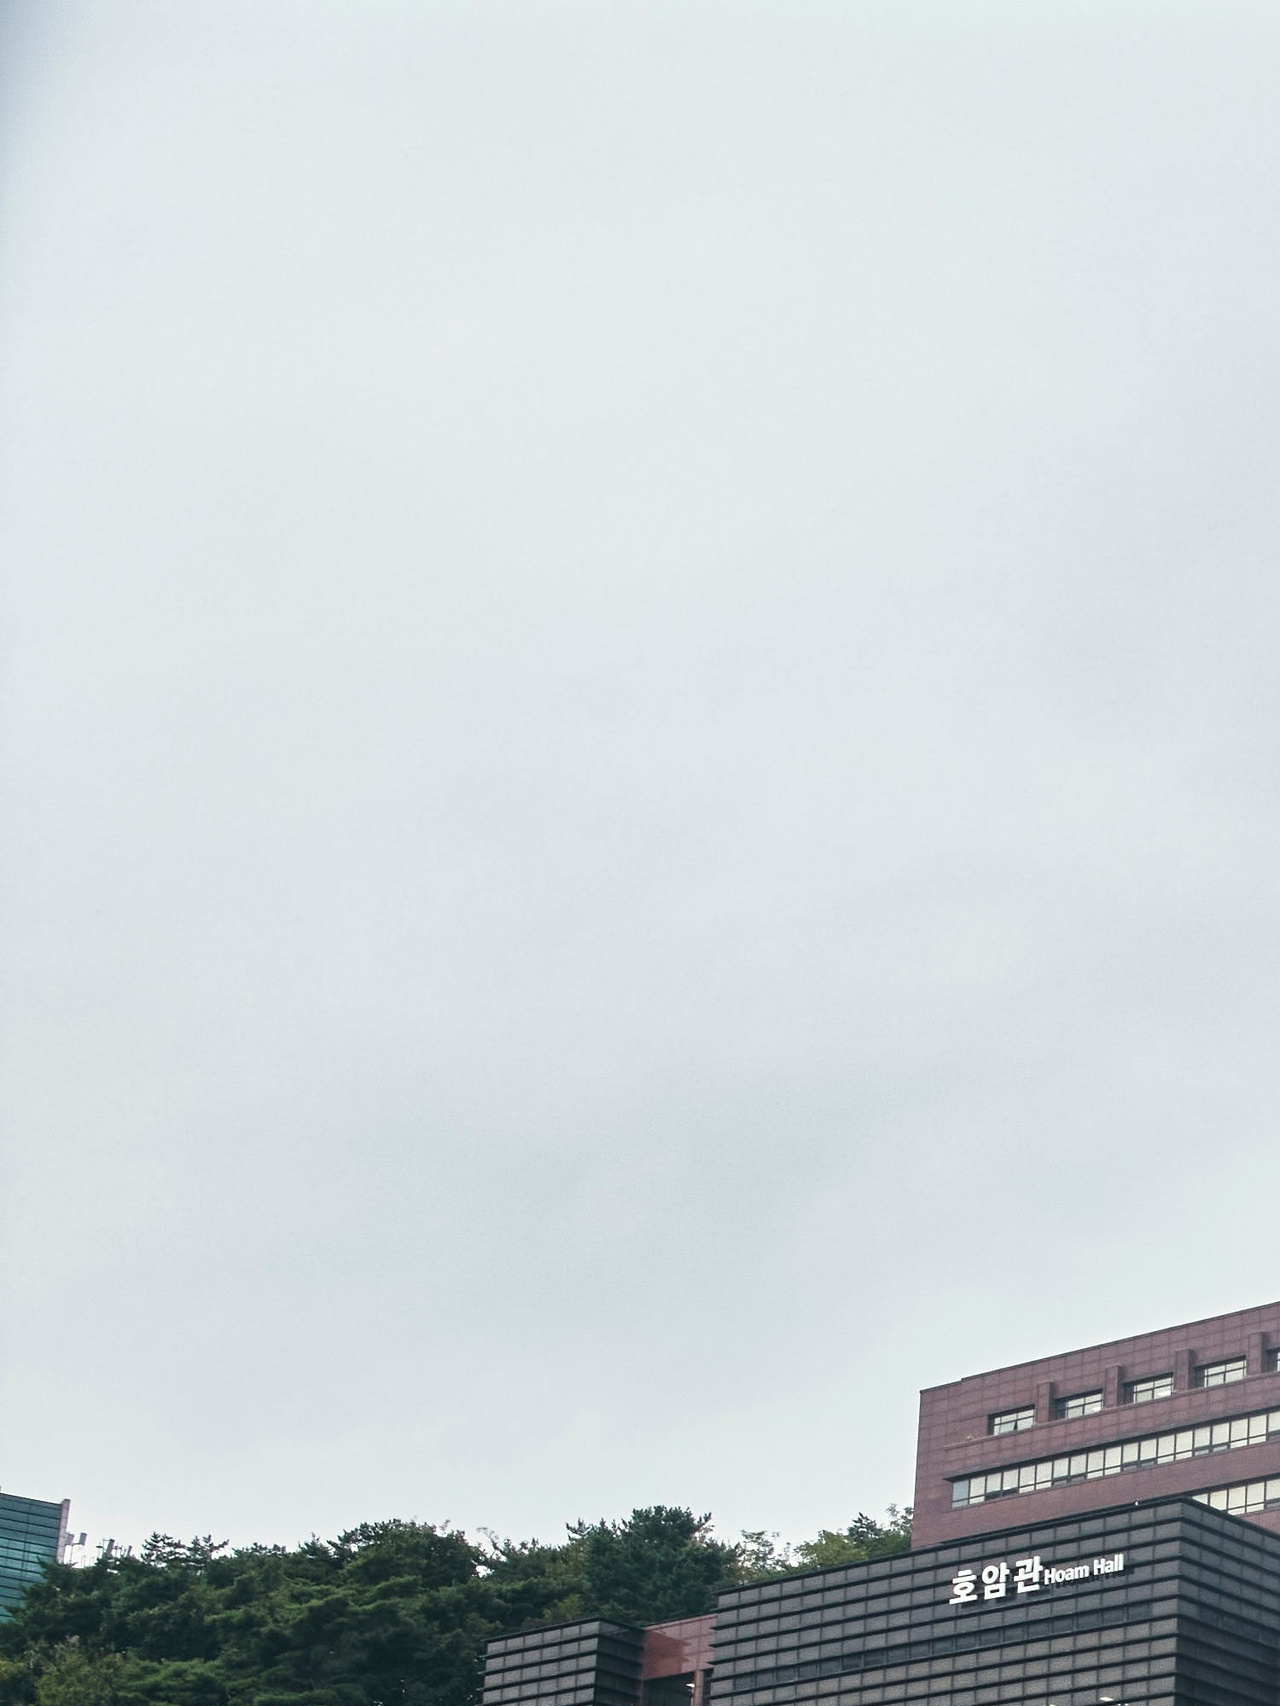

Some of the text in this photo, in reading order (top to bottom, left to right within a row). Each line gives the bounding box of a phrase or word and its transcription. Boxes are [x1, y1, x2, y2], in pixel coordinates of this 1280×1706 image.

[949, 1553, 1125, 1604] 호암관 Hoam Hall
